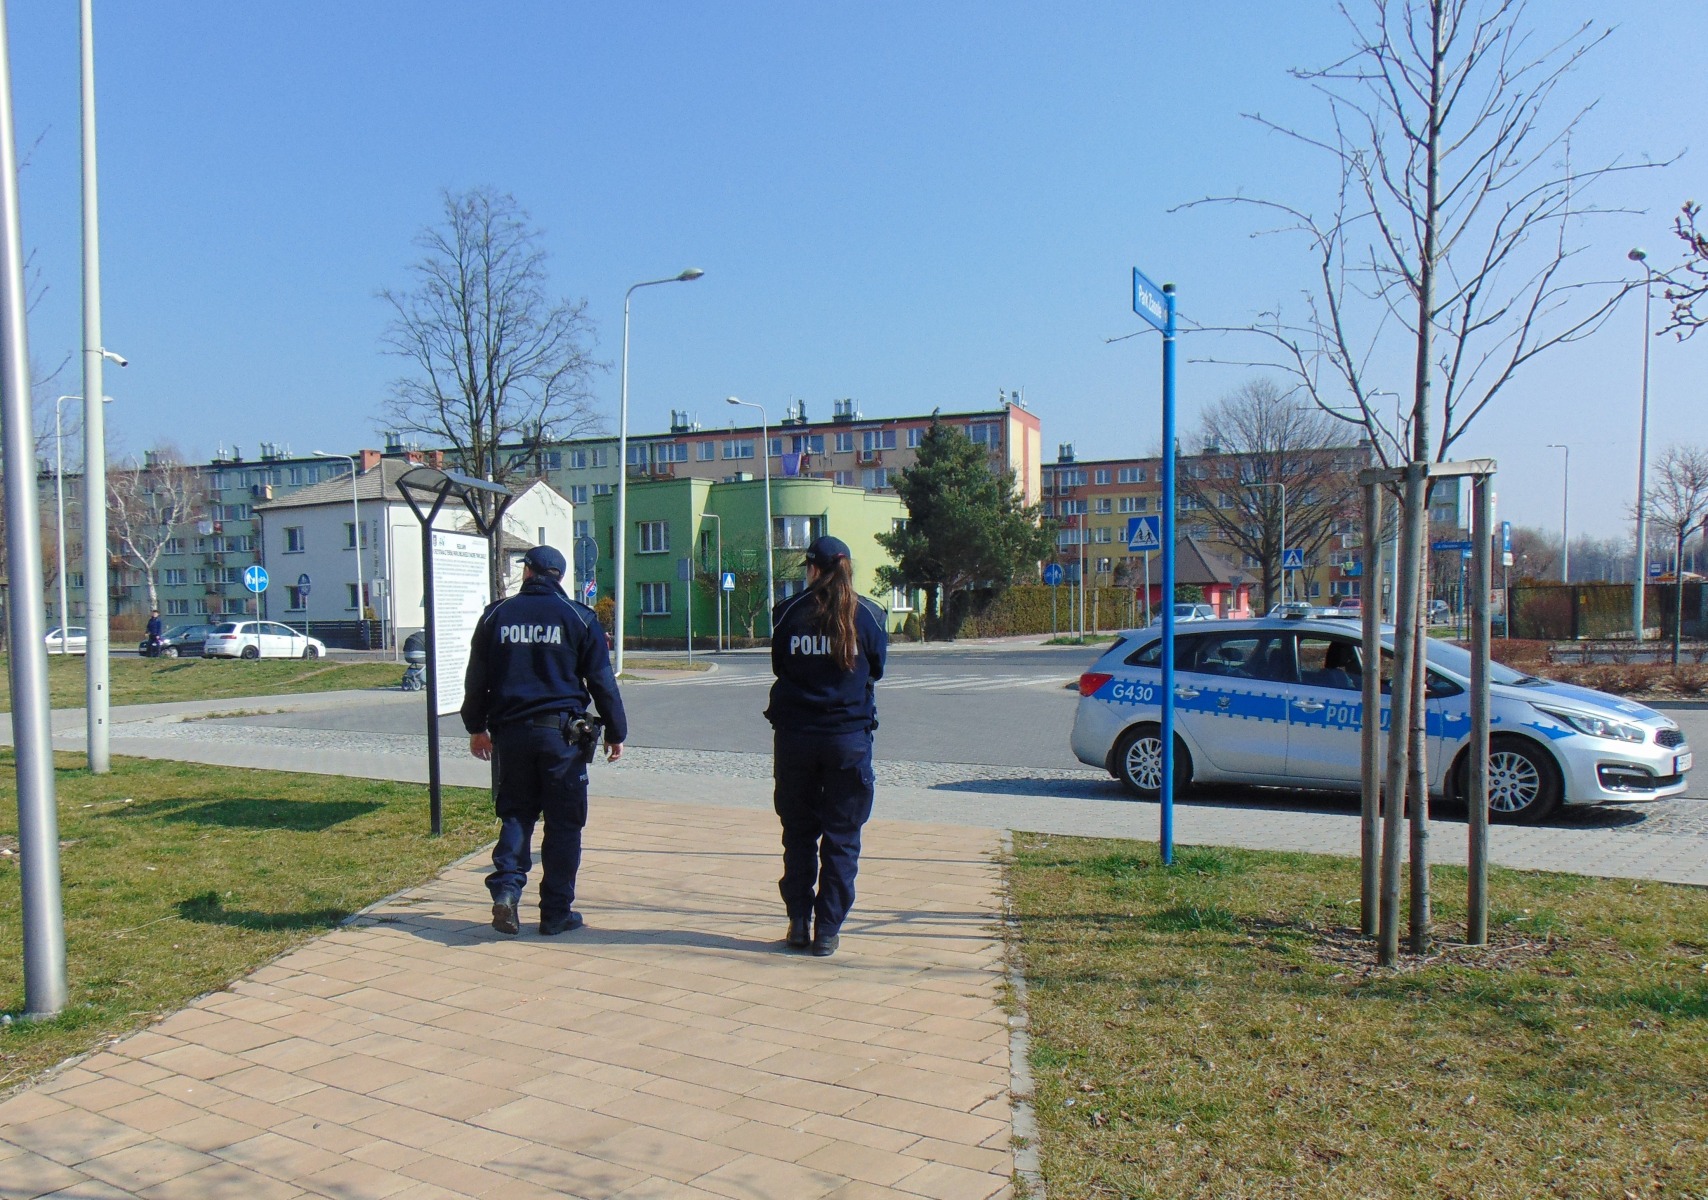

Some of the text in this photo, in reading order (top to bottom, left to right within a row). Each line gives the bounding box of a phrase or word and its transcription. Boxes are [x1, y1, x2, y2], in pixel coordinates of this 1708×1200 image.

[500, 624, 561, 644] POLICJA
[1112, 684, 1153, 701] G430
[1326, 705, 1391, 728] POLJ
